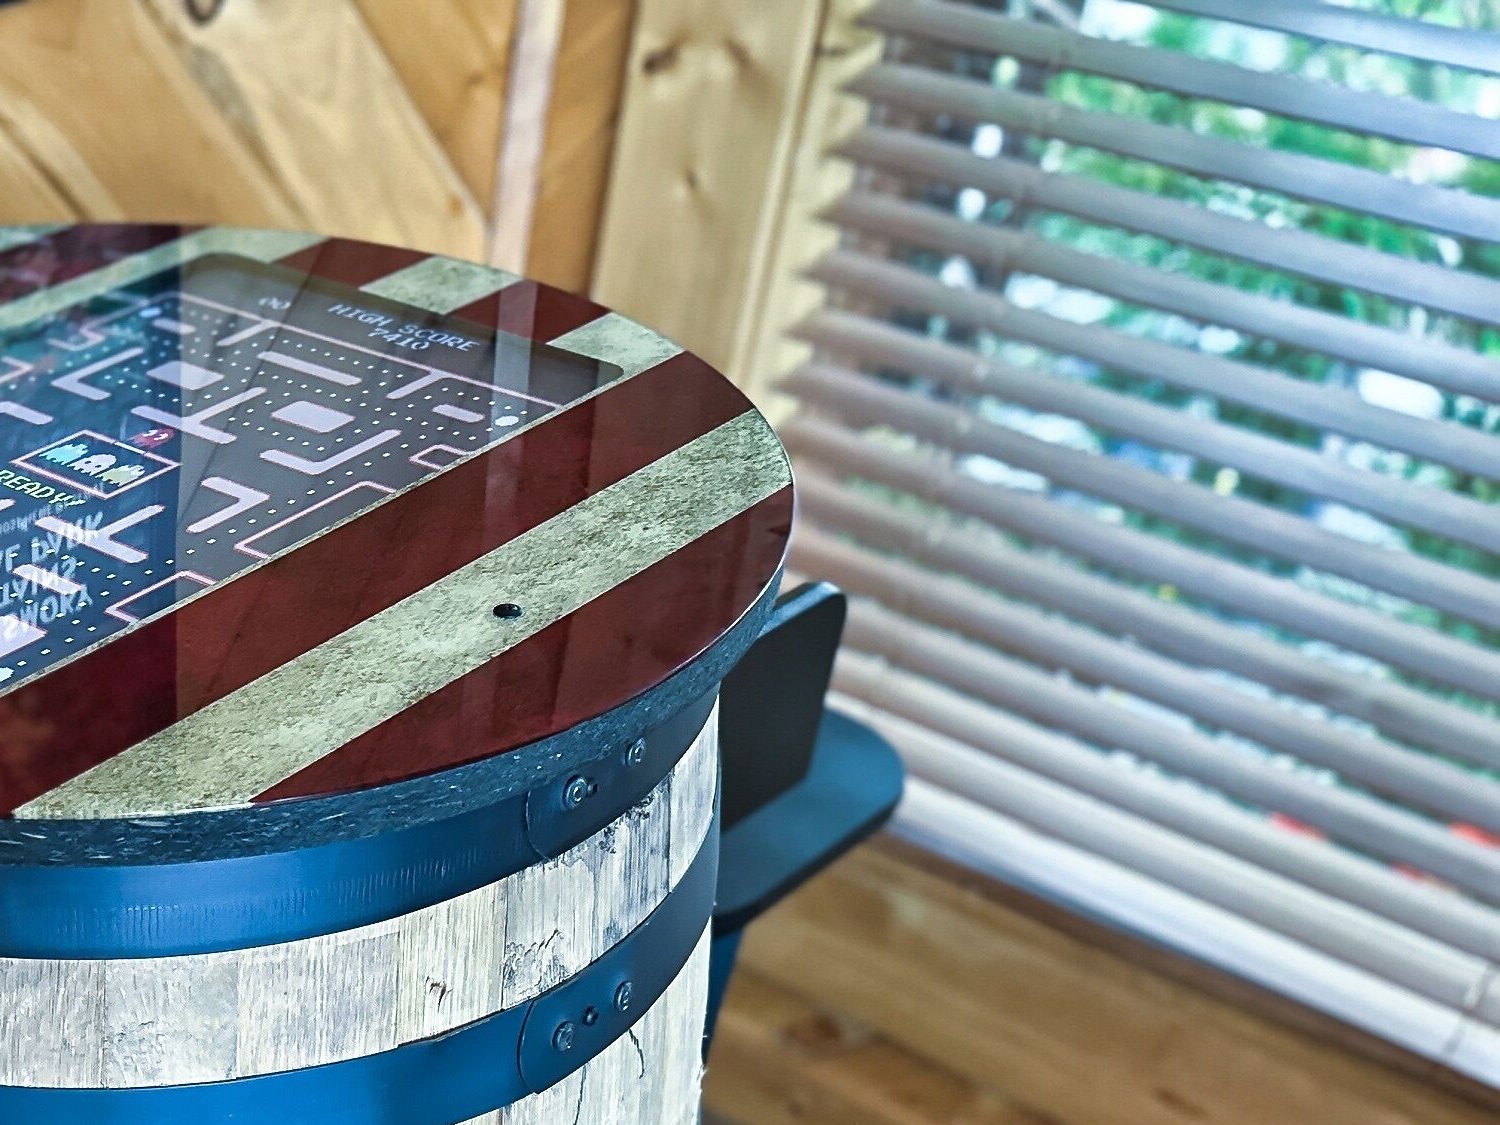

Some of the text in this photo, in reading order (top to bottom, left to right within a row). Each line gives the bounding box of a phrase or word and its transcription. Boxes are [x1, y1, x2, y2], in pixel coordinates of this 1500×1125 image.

[328, 303, 480, 353] HIGH SCORE
[368, 327, 430, 352] 7410
